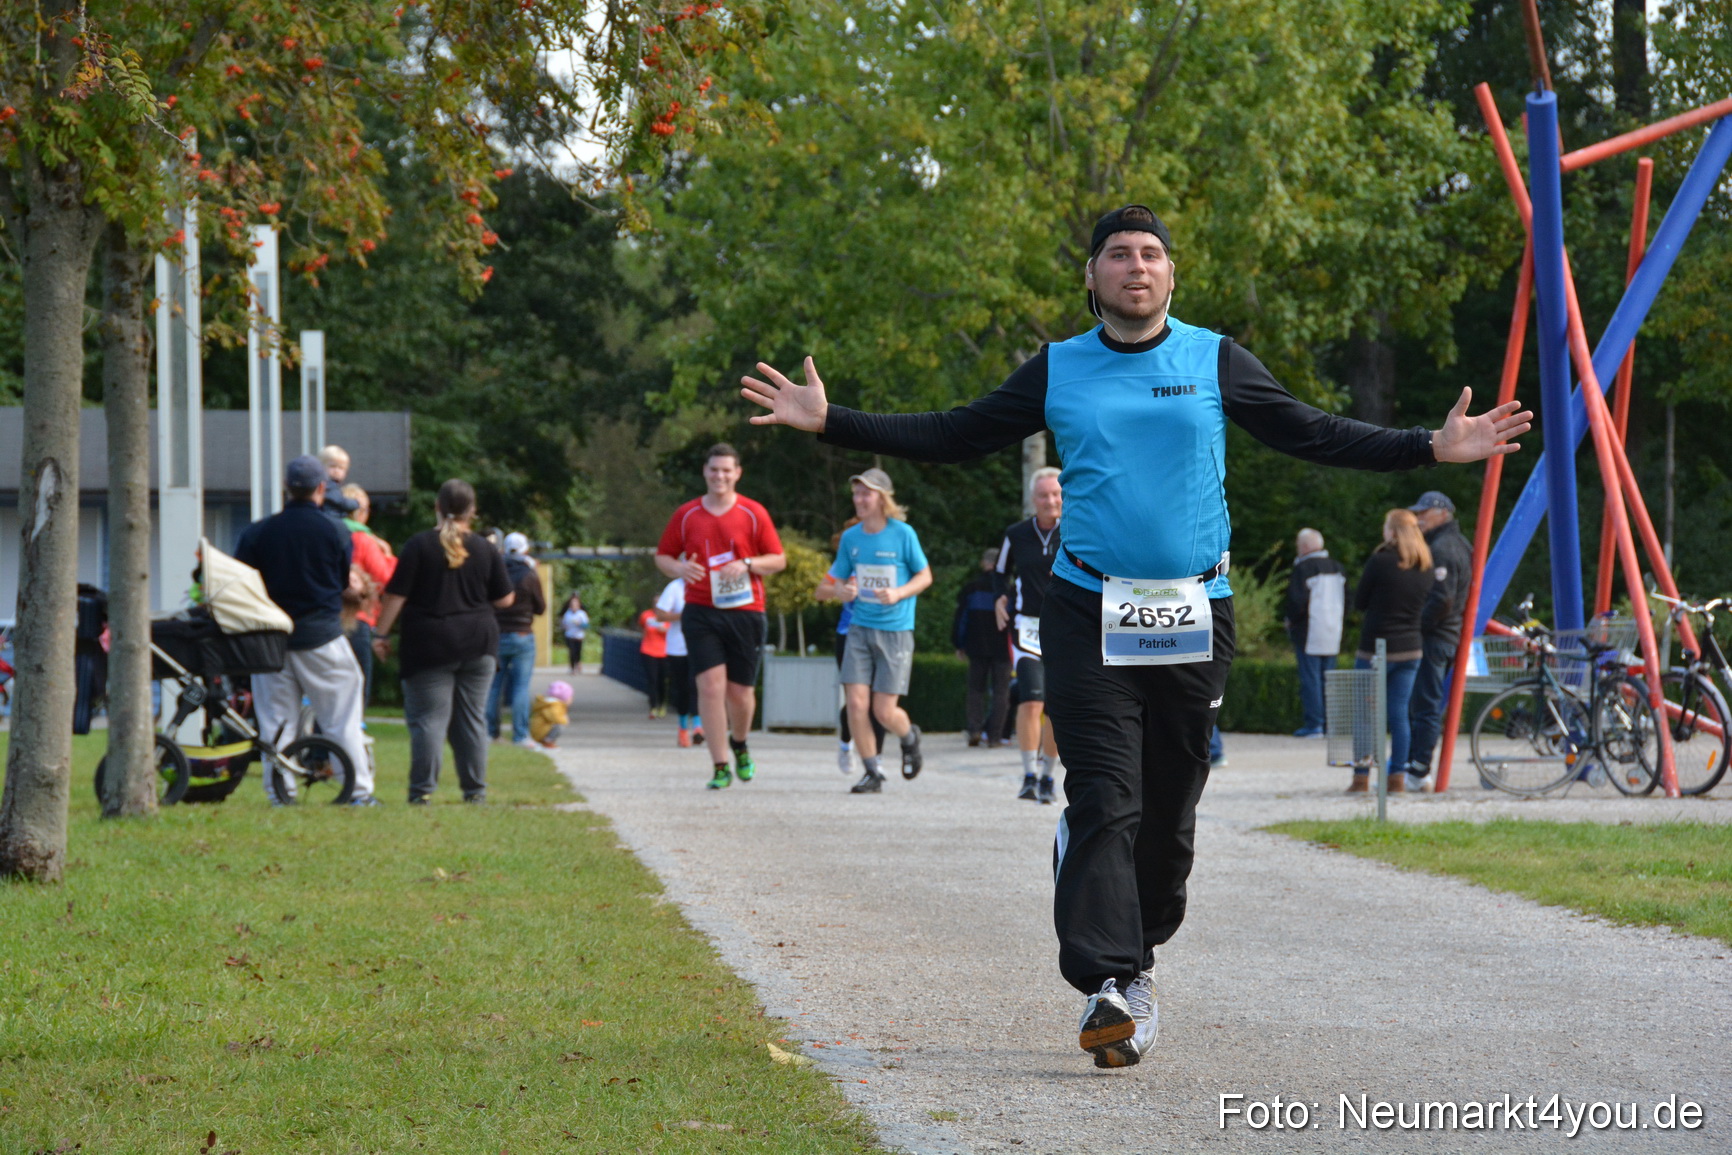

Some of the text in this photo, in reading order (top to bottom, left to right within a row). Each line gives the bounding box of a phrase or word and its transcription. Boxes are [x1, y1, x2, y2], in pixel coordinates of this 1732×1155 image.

[1151, 384, 1198, 398] THULE
[862, 576, 890, 588] 2763
[1119, 602, 1195, 628] 2652
[1139, 638, 1177, 649] Patrick
